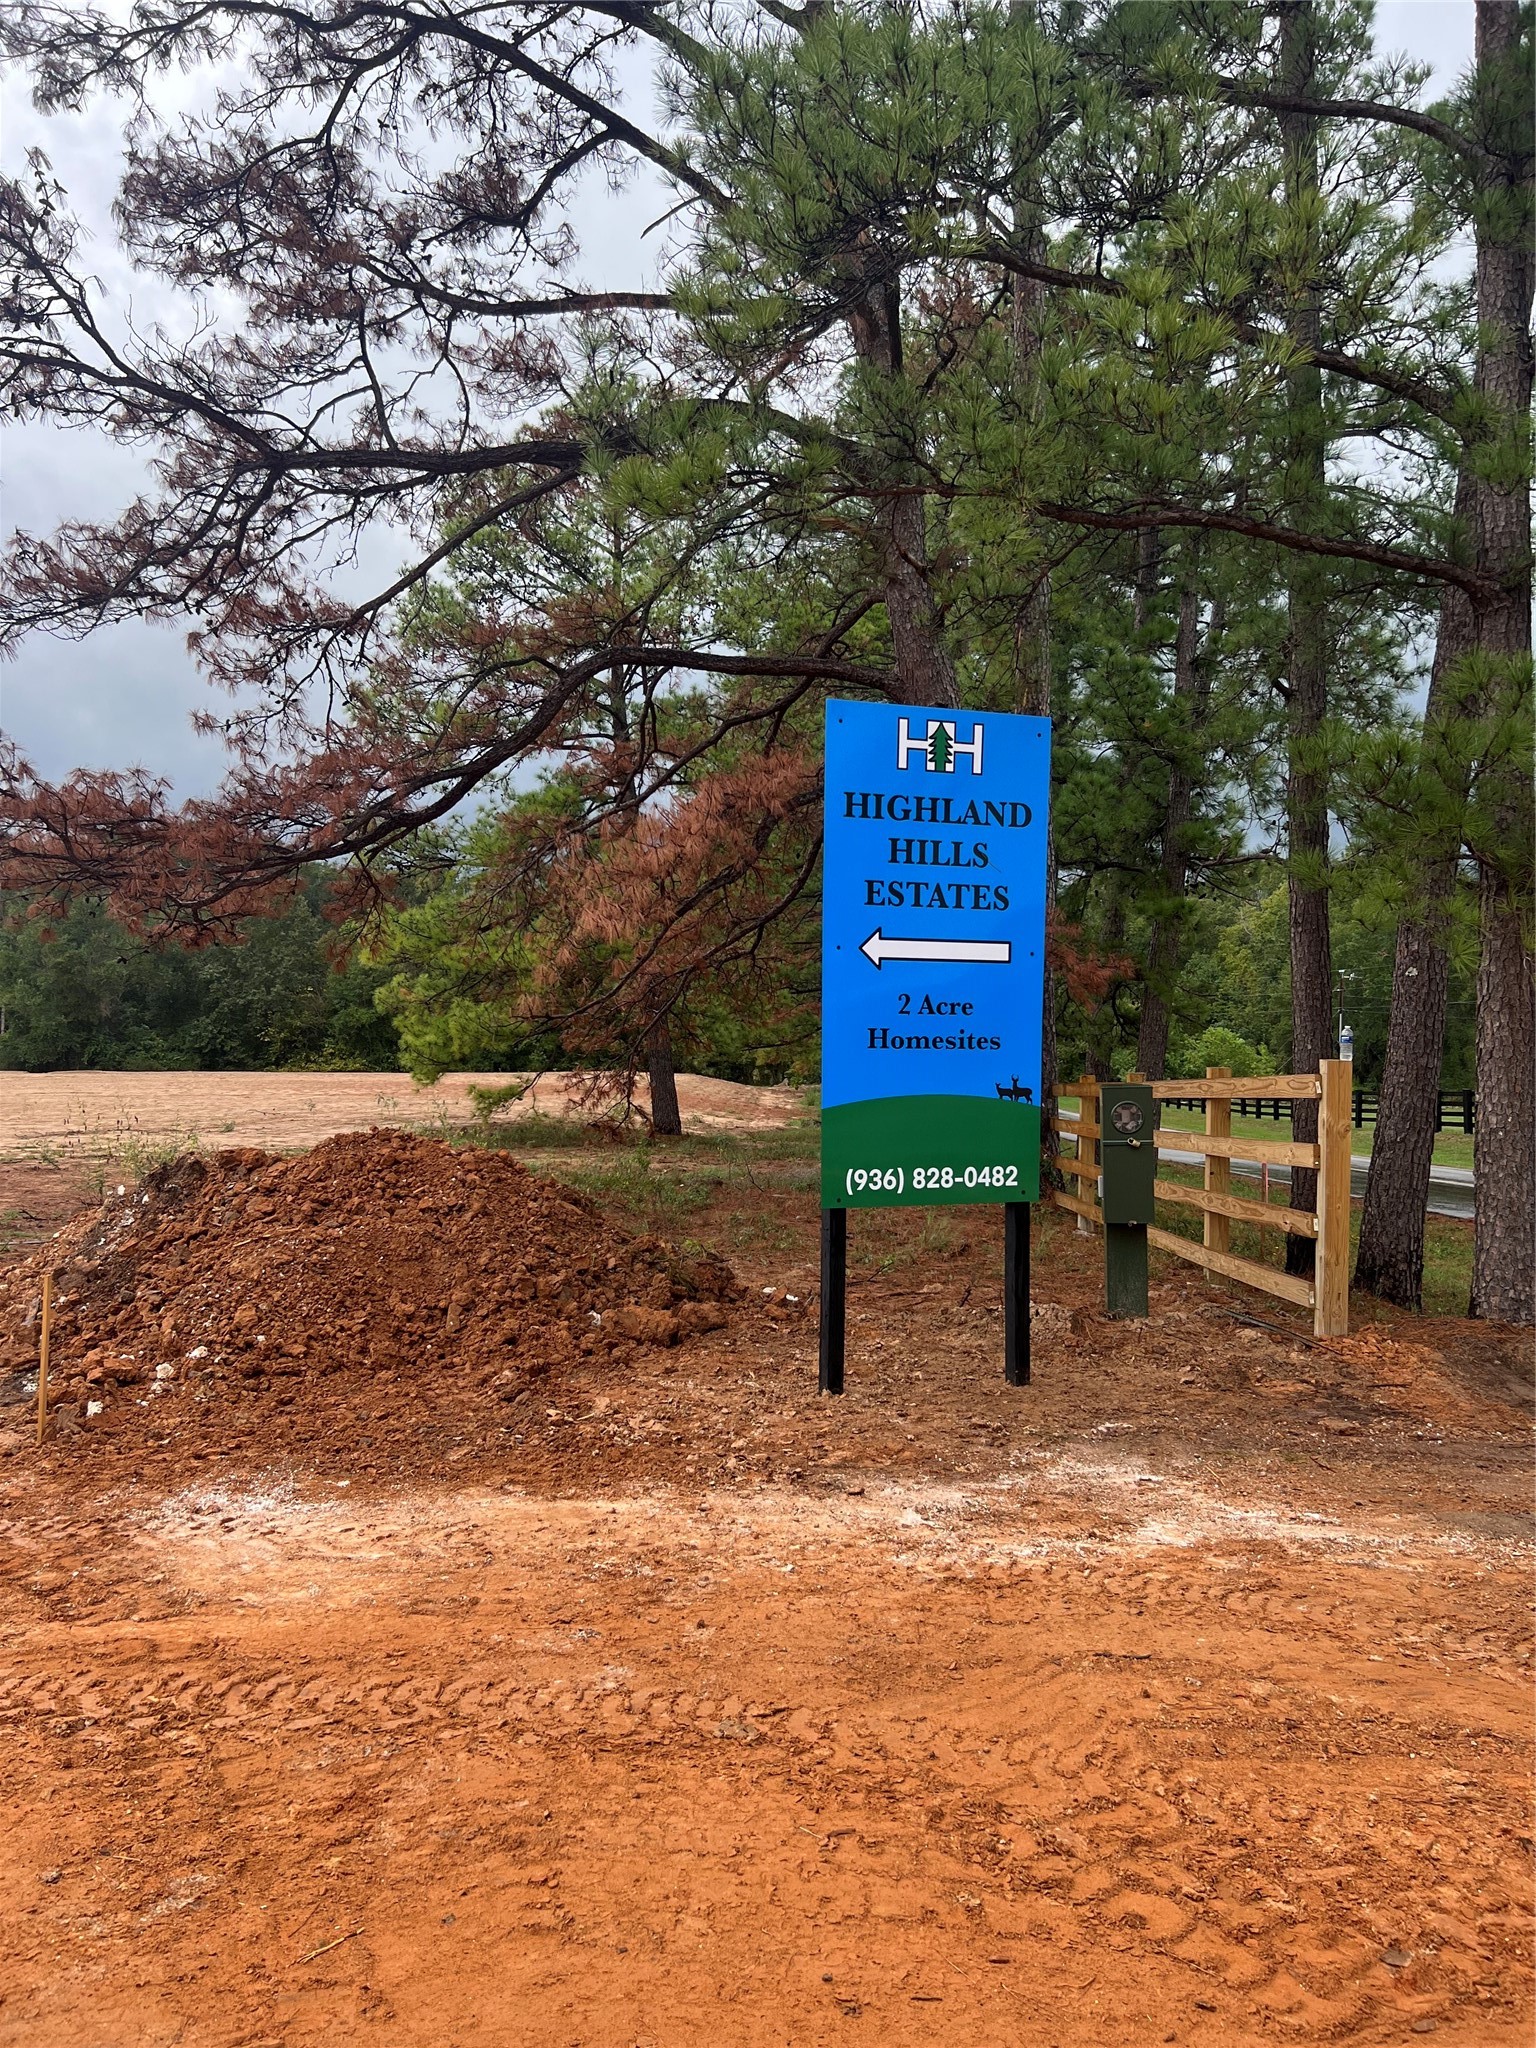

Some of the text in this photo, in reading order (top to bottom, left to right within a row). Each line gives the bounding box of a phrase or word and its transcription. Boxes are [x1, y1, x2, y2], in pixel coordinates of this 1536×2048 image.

[843, 792, 1032, 828] HIGHLAND
[888, 838, 989, 868] HILLS
[864, 880, 1010, 911] ESTATES
[898, 993, 974, 1016] 2 Acre
[867, 1028, 1001, 1050] Homesites
[845, 1165, 1018, 1195] (936) 828-0482
